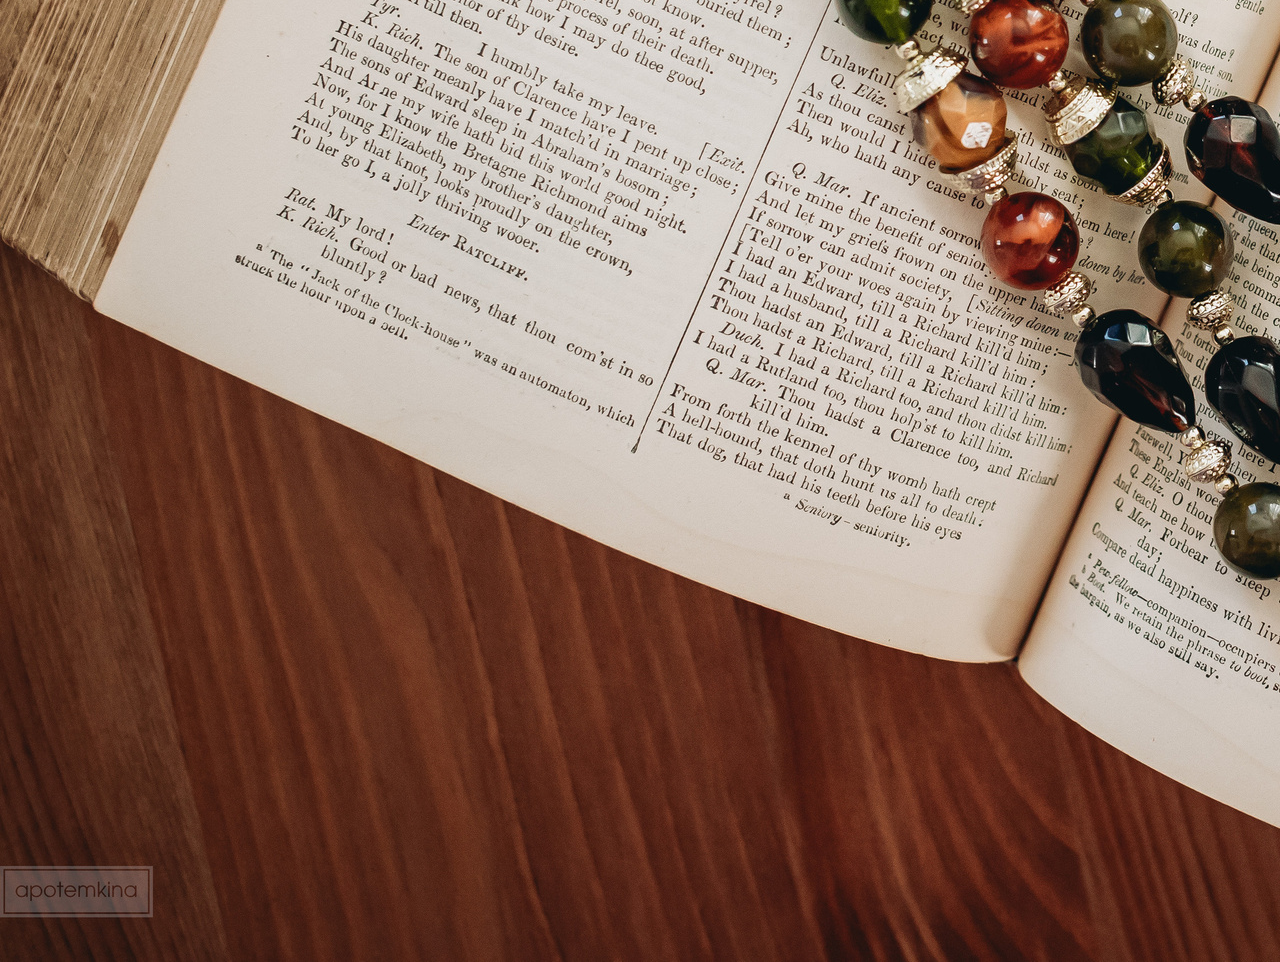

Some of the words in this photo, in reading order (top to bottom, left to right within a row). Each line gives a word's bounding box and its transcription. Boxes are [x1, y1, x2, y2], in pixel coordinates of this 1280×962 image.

[449, 9, 482, 35] then.
[486, 8, 505, 21] of
[506, 13, 530, 36] thy
[534, 27, 578, 57] desire.
[786, 118, 813, 143] Ah,
[821, 134, 850, 154] who
[854, 144, 887, 171] hath
[891, 165, 922, 187] any
[926, 180, 967, 202] cause
[971, 194, 985, 210] to
[406, 213, 450, 241] Enter
[669, 382, 711, 411] From
[716, 403, 751, 427] forth
[757, 419, 780, 438] the
[783, 427, 835, 459] kennel
[838, 453, 858, 465] of
[858, 457, 883, 478] thy
[888, 470, 928, 491] womb
[931, 480, 961, 501] hath
[965, 496, 997, 514] crept
[1113, 612, 1125, 624] as
[1127, 620, 1142, 635] we
[1143, 631, 1166, 649] also
[1168, 643, 1193, 664] still
[1194, 660, 1220, 680] say.
